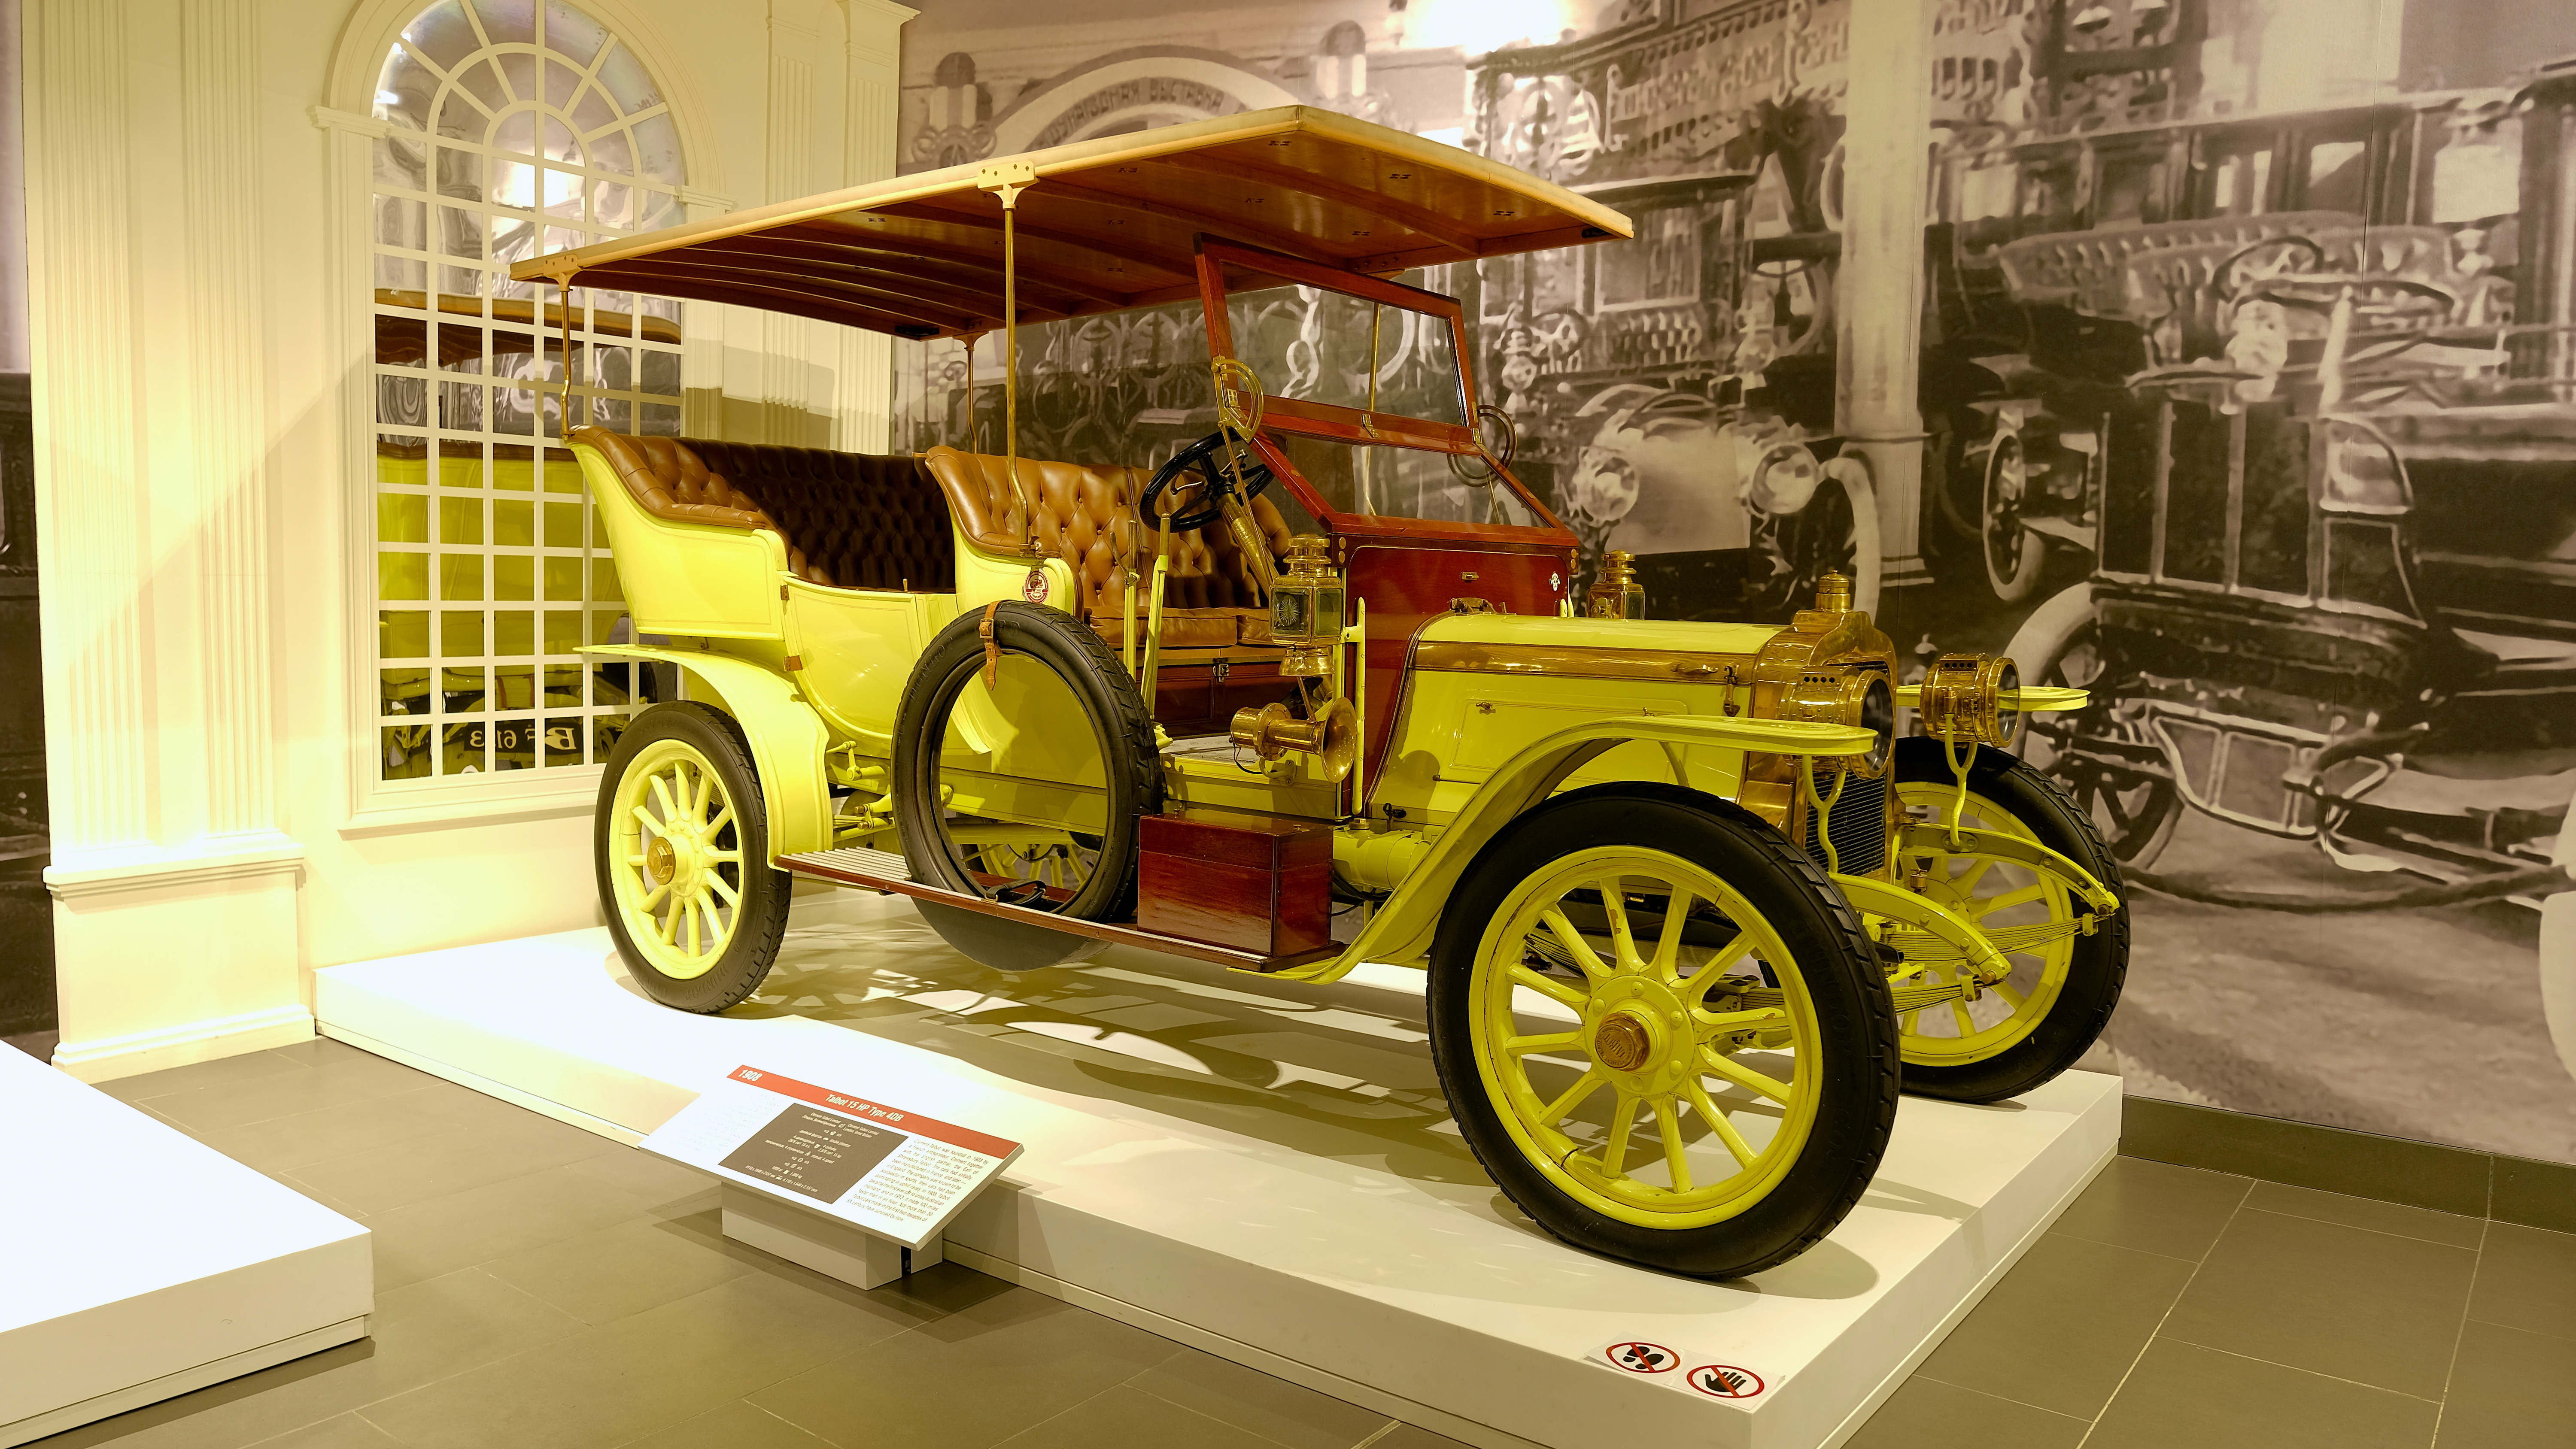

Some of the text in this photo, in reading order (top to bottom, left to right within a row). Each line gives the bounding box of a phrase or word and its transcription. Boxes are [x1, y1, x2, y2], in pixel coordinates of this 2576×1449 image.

[1604, 1034, 1625, 1058] TALBOT
[738, 1070, 762, 1081] 1908
[825, 1094, 849, 1105] Talbot
[868, 1106, 886, 1116] Type
[886, 1112, 903, 1121] 4DB
[901, 1162, 927, 1172] manufactured
[875, 1174, 896, 1183] dominating
[913, 1172, 931, 1181] company
[924, 1197, 944, 1206] Australian
[906, 1212, 922, 1220] decades
